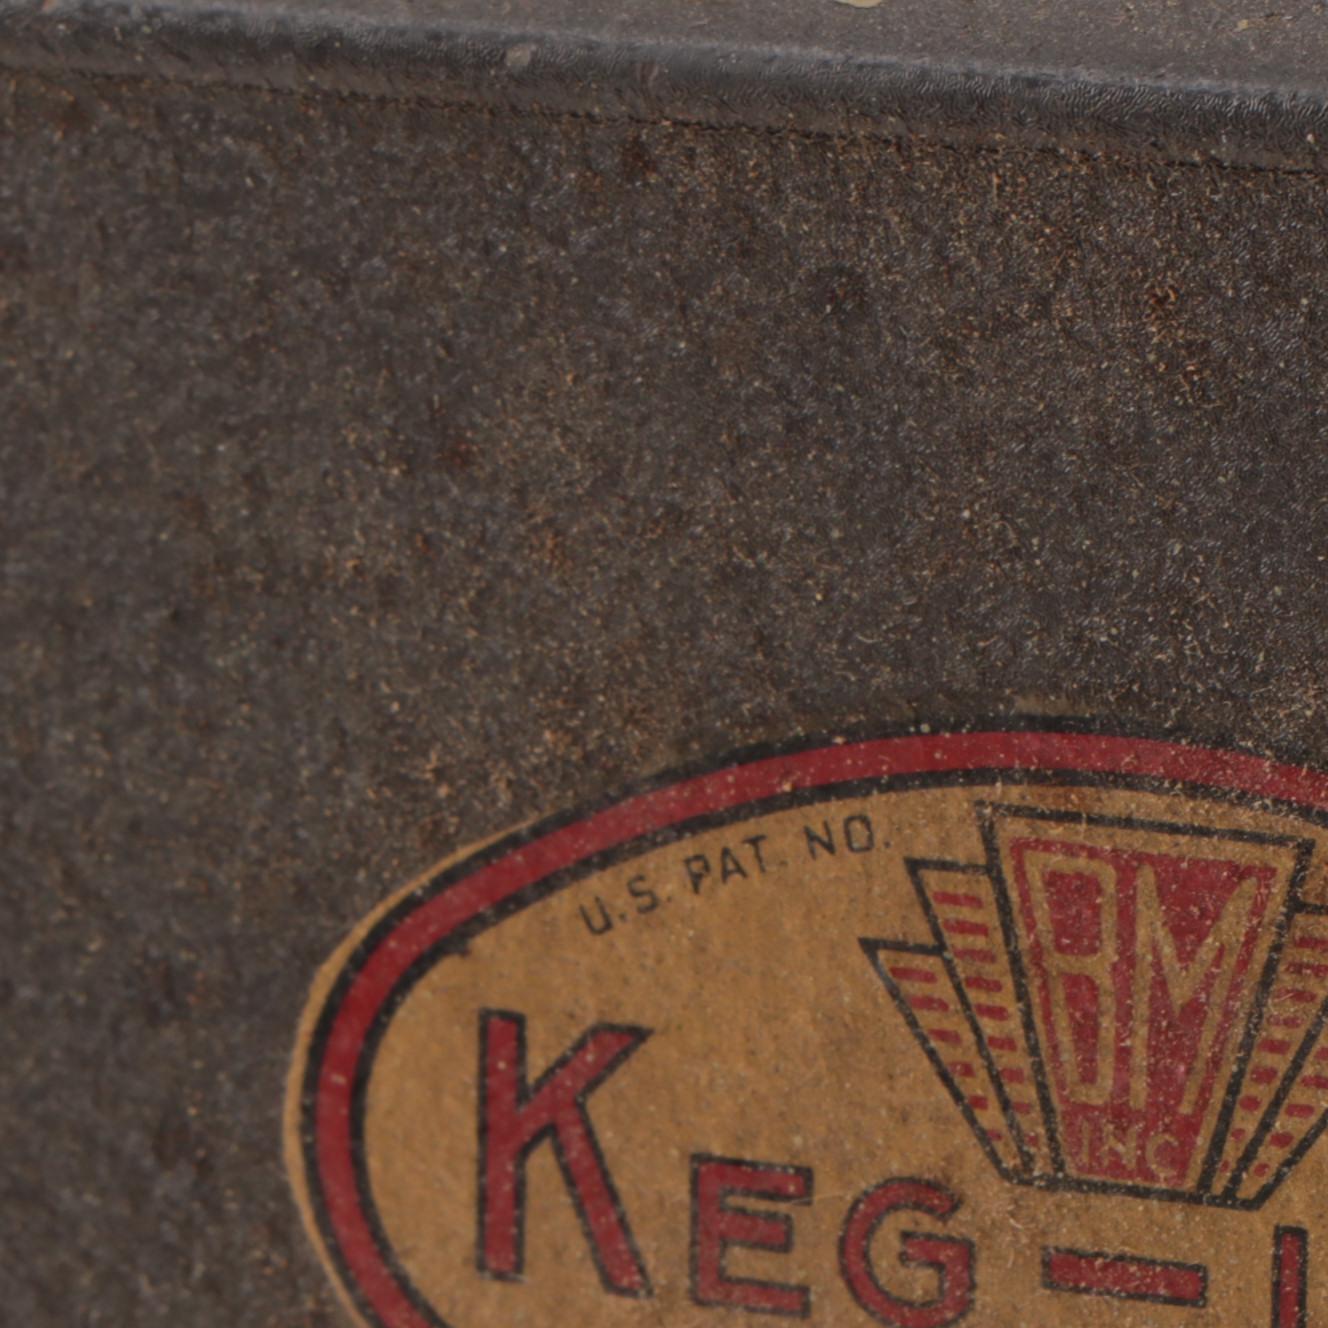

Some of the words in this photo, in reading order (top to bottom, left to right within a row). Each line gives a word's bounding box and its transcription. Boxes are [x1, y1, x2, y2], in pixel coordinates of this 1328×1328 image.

[578, 873, 673, 936] U.S.
[683, 833, 790, 894] PAT.
[803, 814, 892, 860] NO.
